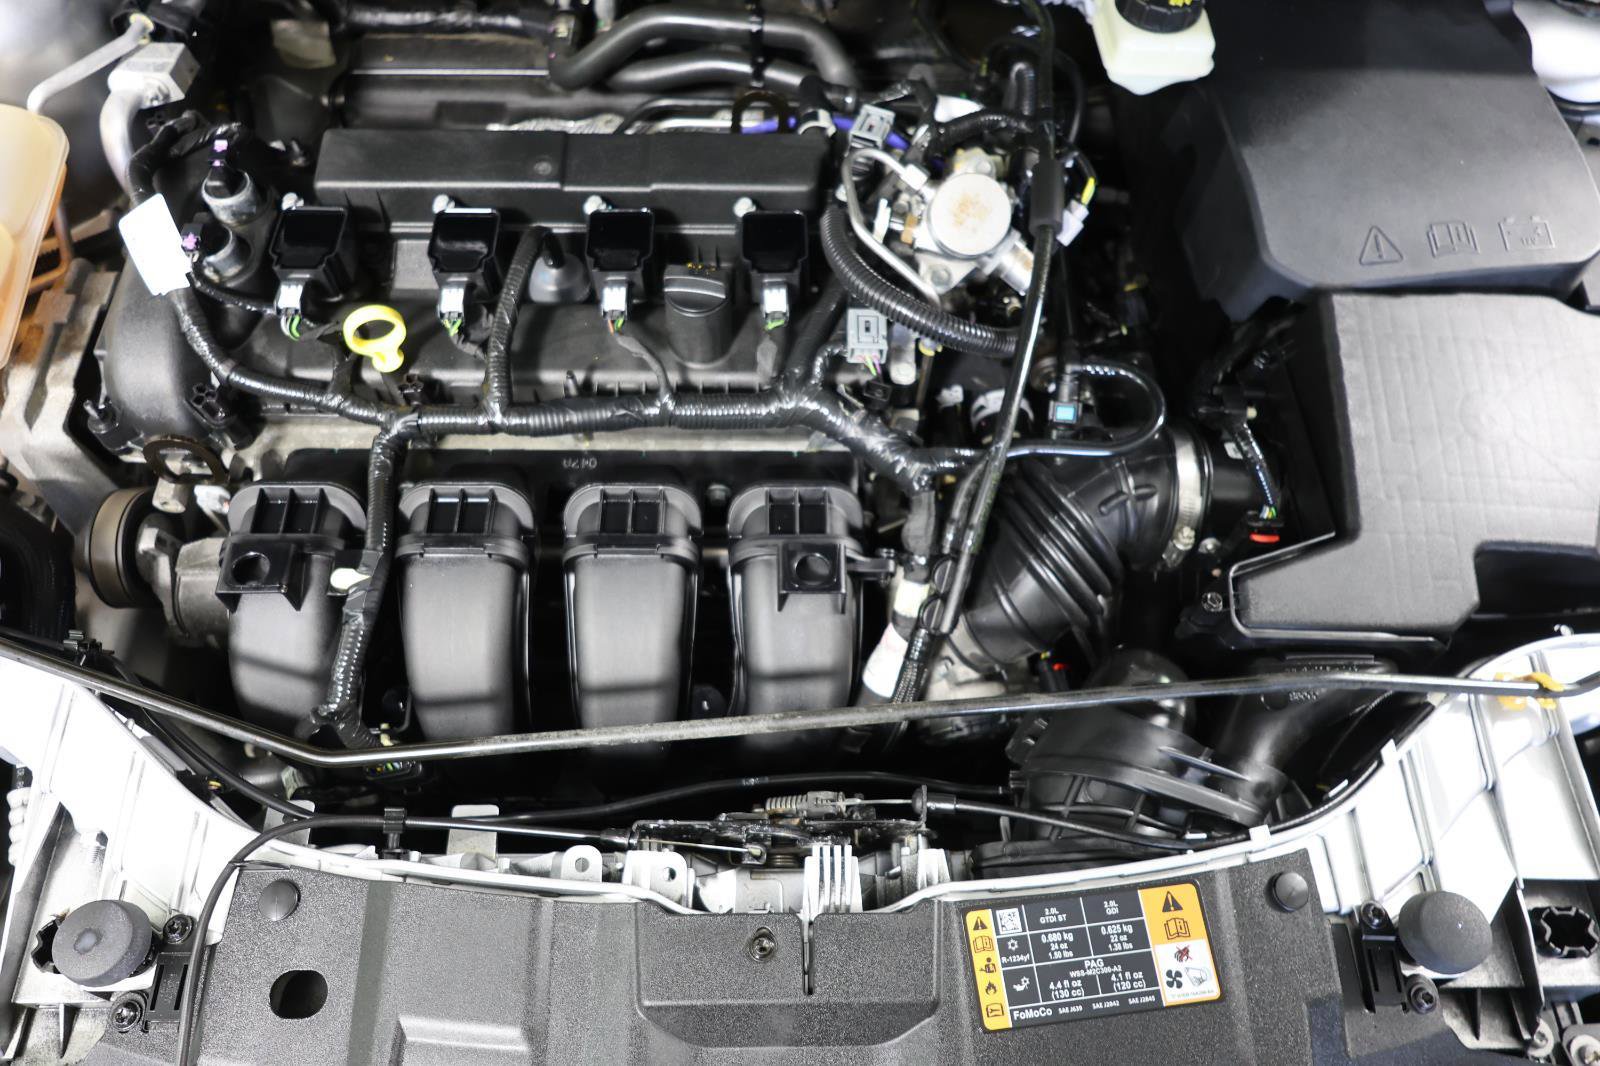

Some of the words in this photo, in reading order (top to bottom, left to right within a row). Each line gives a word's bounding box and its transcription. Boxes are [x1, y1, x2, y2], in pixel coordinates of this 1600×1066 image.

[1103, 900, 1119, 908] 2.0L
[1044, 907, 1059, 915] 2.0L
[1101, 925, 1121, 935] 0.625
[1122, 923, 1133, 934] kg
[1041, 933, 1061, 943] 0.680
[1063, 932, 1073, 942] kg
[1050, 943, 1059, 951] 24
[1108, 943, 1122, 951] 1.38
[1122, 942, 1133, 950] lbs
[1001, 953, 1030, 963] R-1234yf
[1048, 951, 1062, 960] 1.50
[1063, 950, 1073, 958] lbs
[1084, 959, 1104, 968] PAG
[1110, 973, 1124, 982] 4.1
[1125, 971, 1132, 980] fl
[1133, 971, 1143, 979] oz
[1049, 981, 1063, 990] 4.4
[1063, 979, 1070, 988] fl
[1113, 981, 1132, 992] (120
[1133, 979, 1146, 989] cc)
[1051, 990, 1069, 1001] (130
[1071, 987, 1085, 997] cc)
[1128, 997, 1139, 1005] SAE
[1013, 1007, 1052, 1020] FoMoCo
